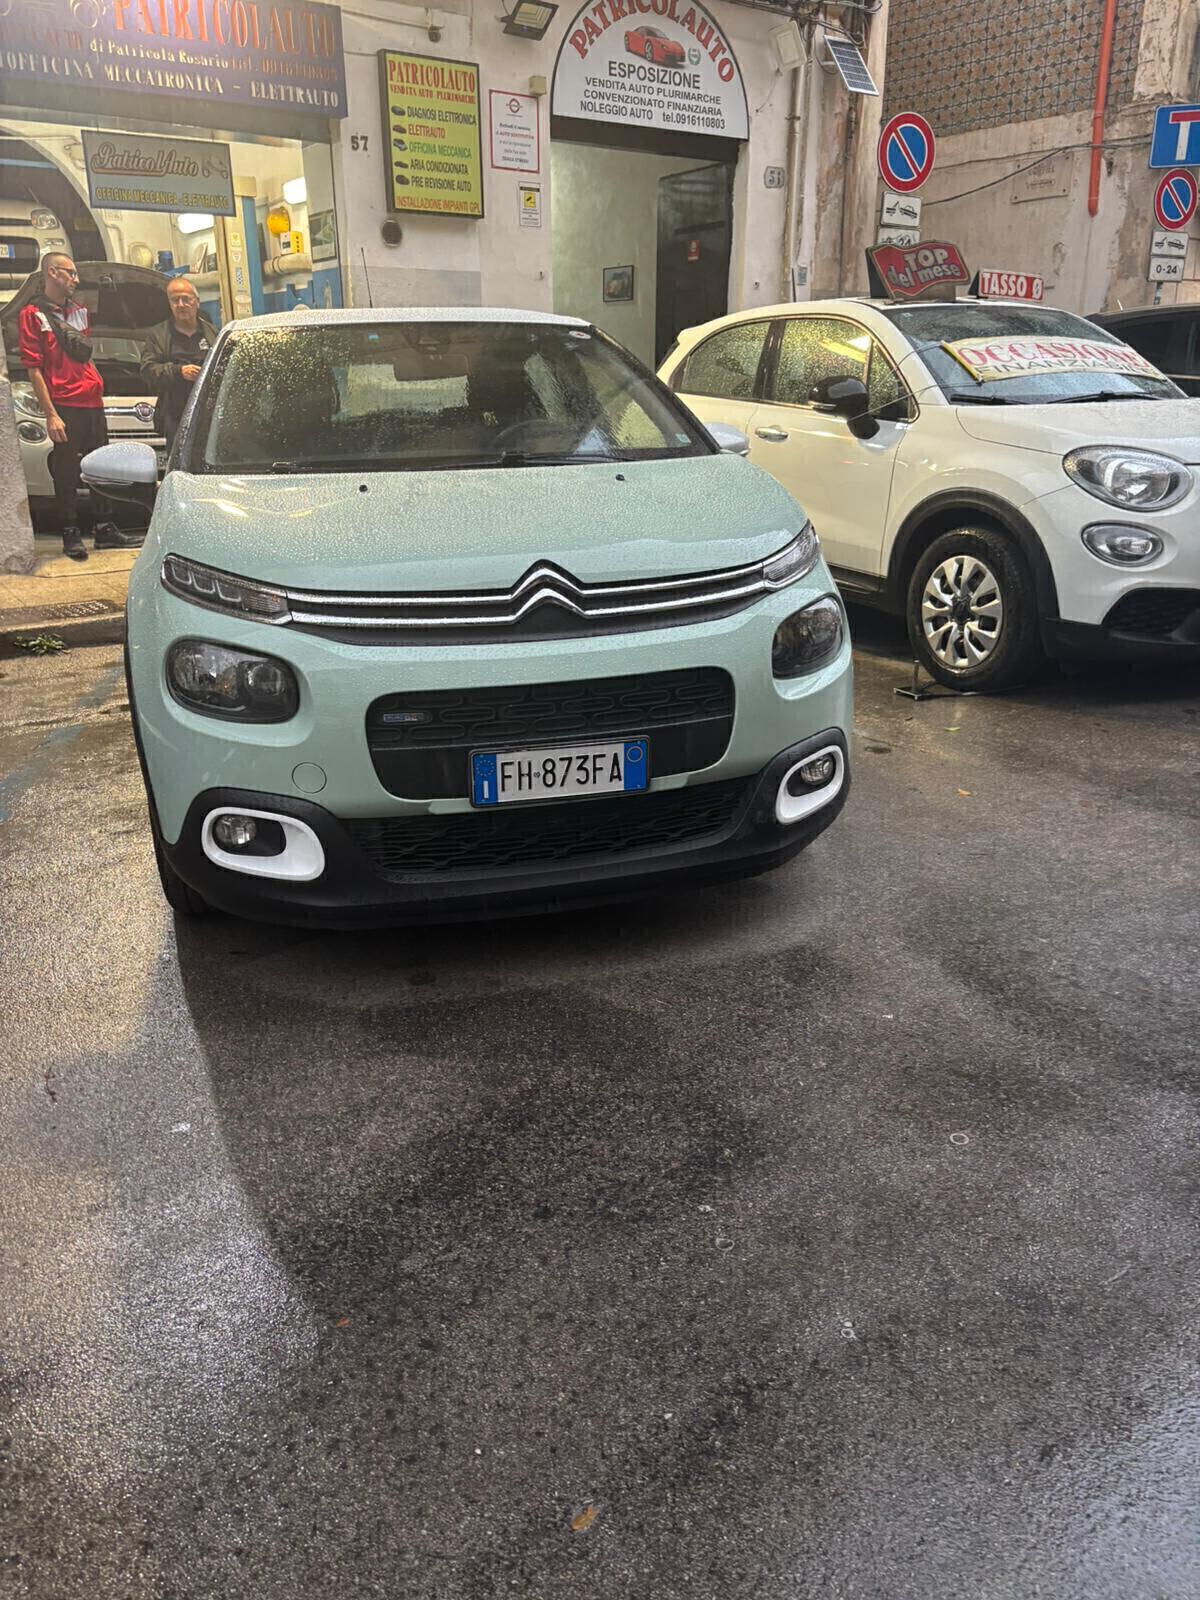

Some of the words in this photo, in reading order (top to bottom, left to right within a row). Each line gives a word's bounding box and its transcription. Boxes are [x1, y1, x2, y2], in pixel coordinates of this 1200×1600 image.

[115, 0, 336, 57] PATRICOLAUTO
[90, 38, 104, 53] di
[108, 40, 176, 62] Patricola
[179, 49, 229, 69] Rosario
[569, 0, 735, 83] PATRICOLAUTO
[104, 63, 224, 94] MECCATRONICA
[250, 81, 339, 108] ELETTRAUTO
[389, 60, 475, 93] PATRICOLAUTO
[608, 60, 701, 90] ESPOSIZIONE
[390, 84, 417, 96] VENDITA
[419, 88, 433, 99] AUTO
[584, 89, 665, 109] CONVENZIONATO
[667, 101, 723, 116] FINANZIARIA
[585, 77, 627, 91] VENDITA
[628, 84, 655, 95] AUTO
[656, 87, 721, 105] PLURIMARCHE
[407, 106, 437, 121] DIAGNOSI
[438, 110, 477, 125] ELETTRONICA
[580, 100, 628, 116] NOLEGGIO
[629, 107, 653, 120] AUTO
[662, 111, 725, 130] tel.0916110803
[351, 136, 369, 151] 57
[408, 124, 446, 139] ELETTRAUTO
[409, 142, 437, 154] OFFICINA
[438, 144, 473, 159] MECCANICA
[410, 159, 425, 170] ARIA
[426, 161, 469, 175] CONDIZIONATA
[411, 176, 424, 187] PRE
[425, 178, 456, 191] REVISIONE
[457, 181, 472, 192] AUTO
[96, 187, 132, 201] OFFICINA
[133, 189, 177, 205] MECCANICA
[183, 193, 228, 209] ELETTRAUTO
[396, 196, 442, 209] INSTALLAZIONE
[443, 199, 469, 212] IMPIANTI
[904, 249, 949, 271] TOP
[1156, 264, 1178, 275] 0-24
[887, 265, 916, 287] del
[917, 263, 961, 283] mese
[983, 272, 1027, 297] TASSO
[958, 341, 1150, 367] OCCASIONE
